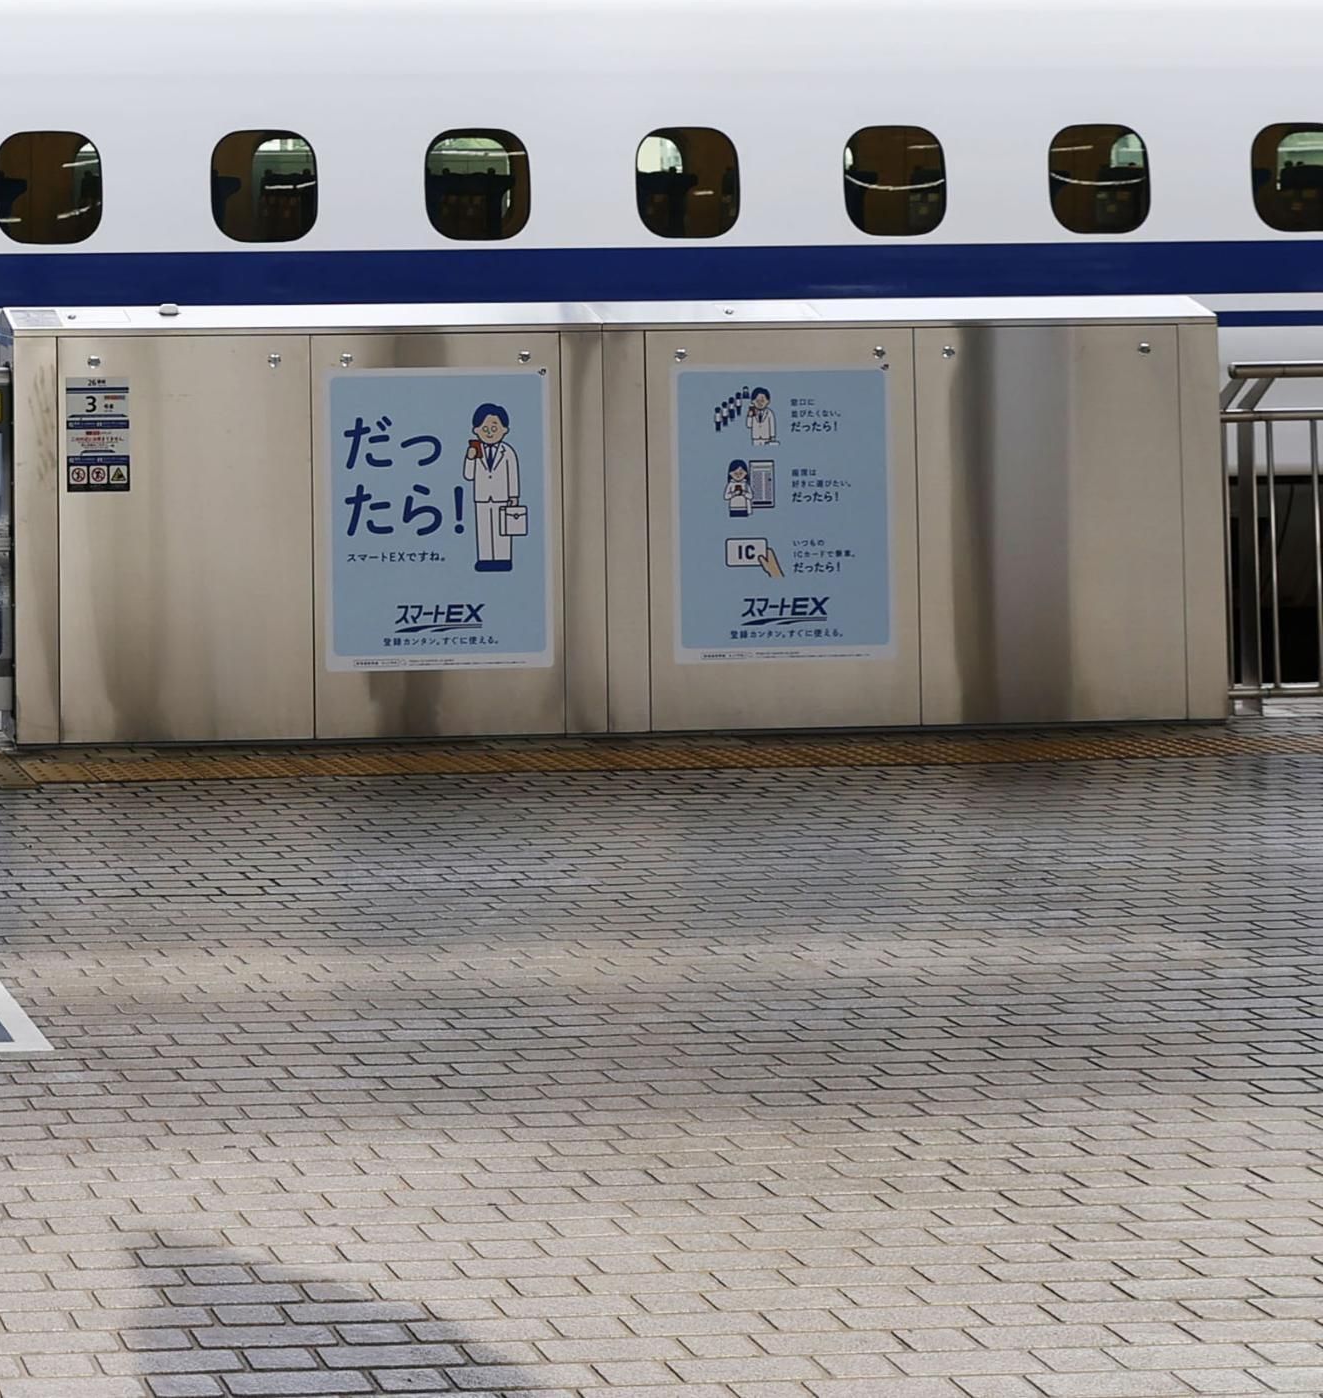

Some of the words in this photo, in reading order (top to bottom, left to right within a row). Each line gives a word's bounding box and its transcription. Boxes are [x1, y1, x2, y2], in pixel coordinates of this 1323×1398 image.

[85, 395, 97, 413] 3
[343, 415, 443, 470] だっ
[344, 484, 465, 537] たら!
[346, 551, 447, 563] スマートEXですね。
[737, 545, 756, 560] IC
[395, 604, 486, 624] スマートEX
[741, 597, 831, 617] スマートEX
